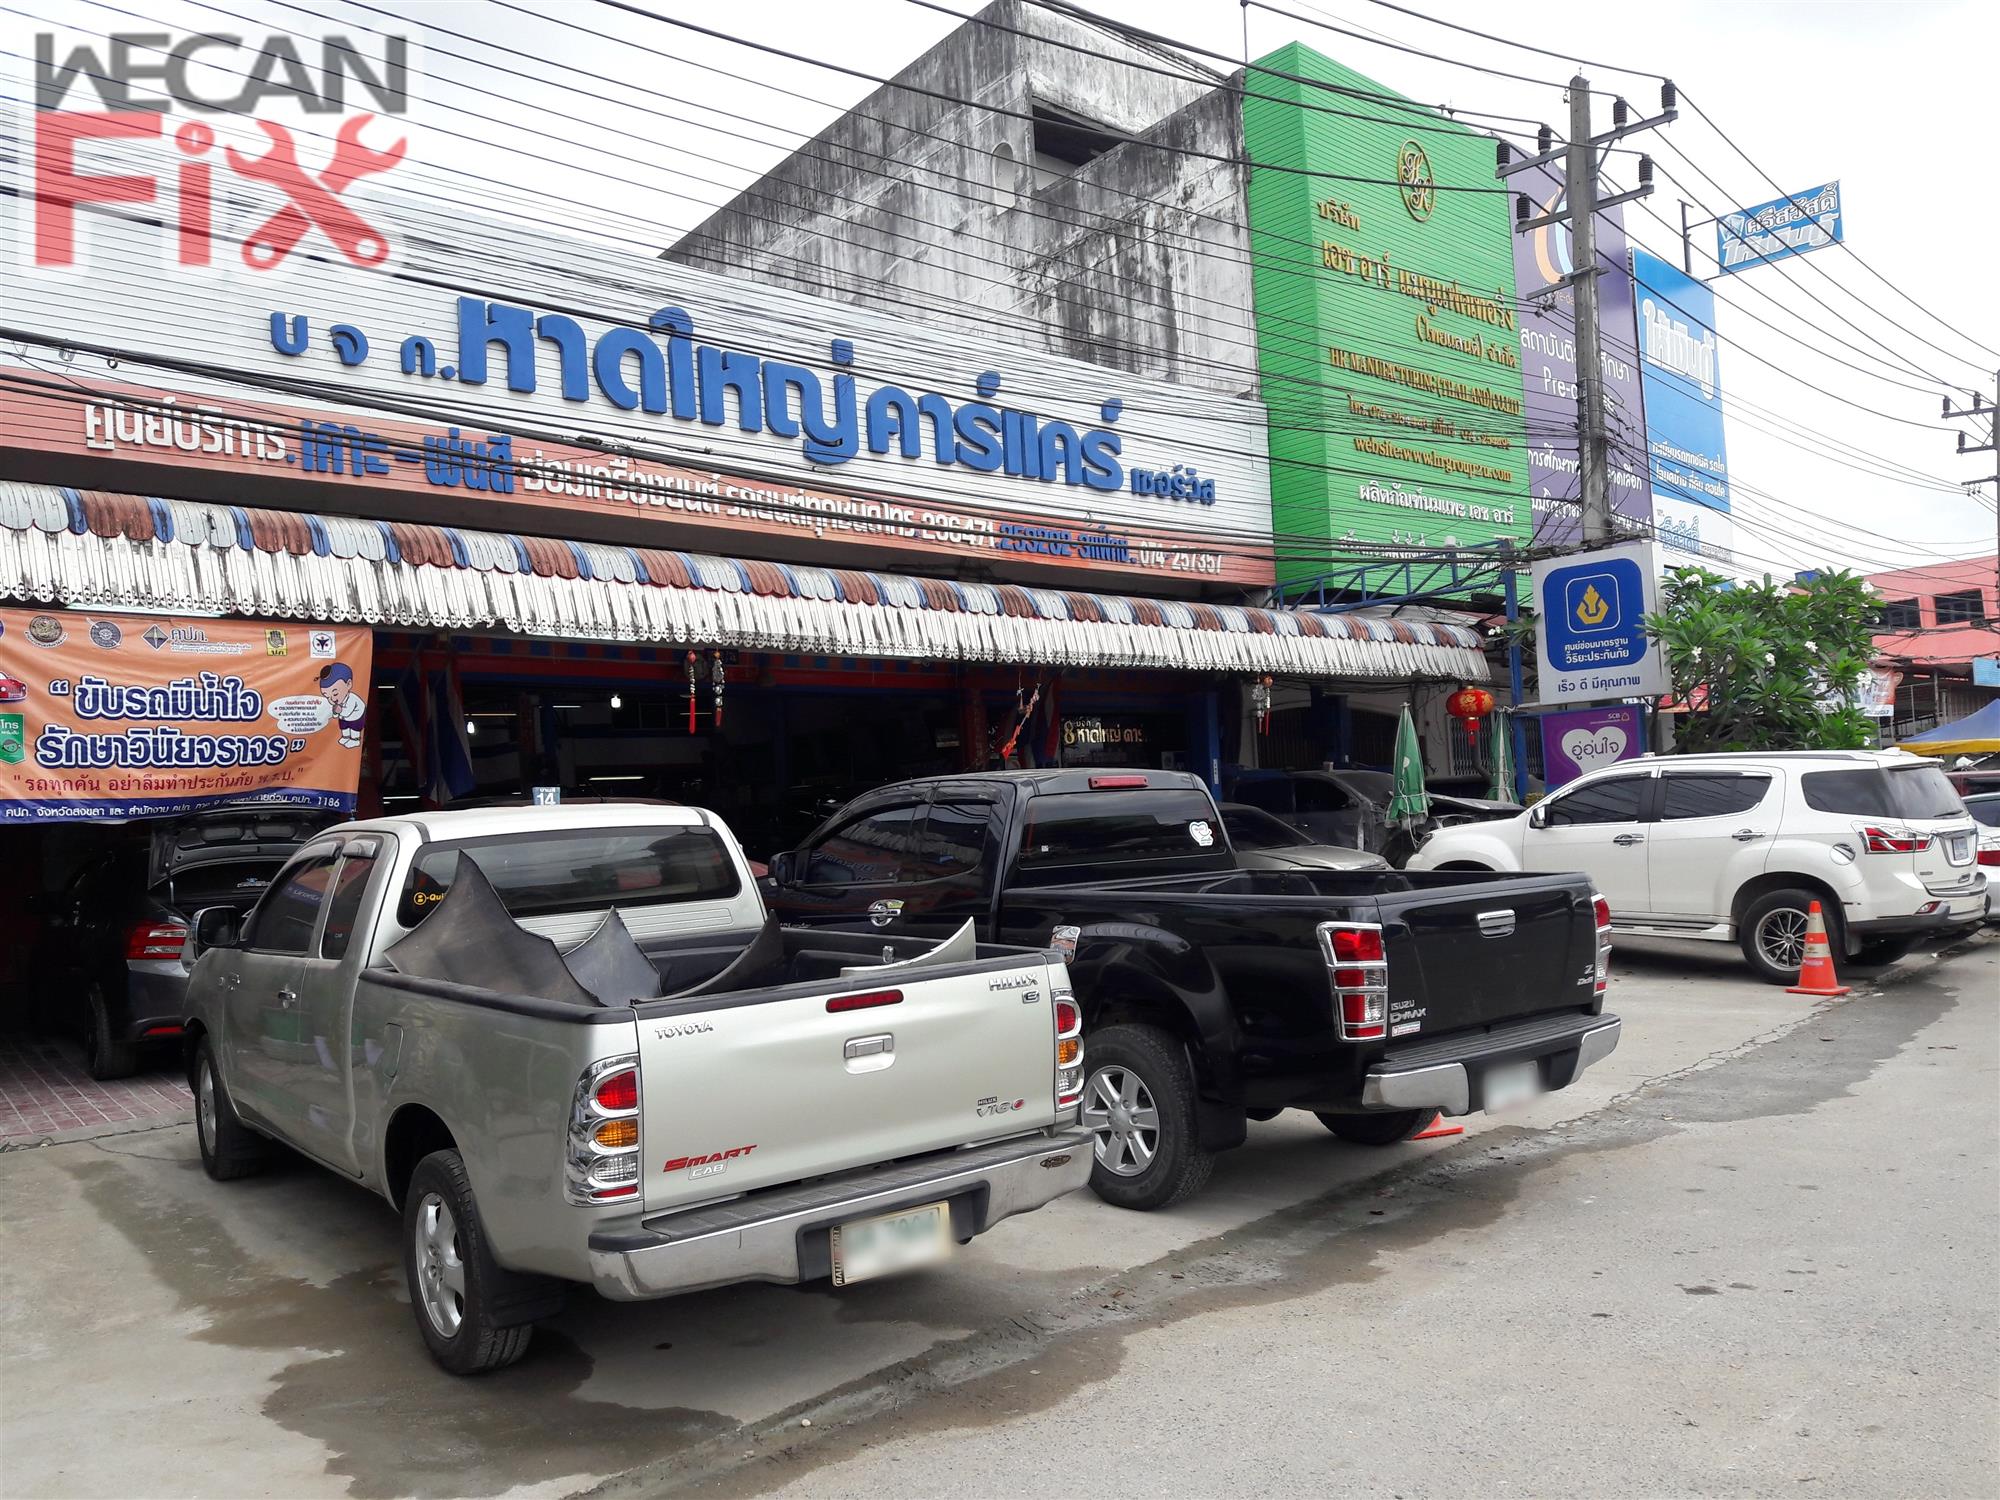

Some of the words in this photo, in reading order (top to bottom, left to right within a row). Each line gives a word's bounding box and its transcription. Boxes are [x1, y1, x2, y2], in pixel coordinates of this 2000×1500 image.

[1318, 198, 1361, 231] บริษัท
[458, 296, 1125, 492] หาดใหญ่คาร์แคร์
[1130, 463, 1216, 506] เซอร์วิส
[424, 427, 514, 494] พ่นสี
[1469, 505, 1490, 521] เอช
[1494, 505, 1514, 525] อาร์
[1564, 637, 1629, 652] ศูนย์ซ่อมมาตรฐาน
[1565, 648, 1630, 664] วิริยะประกันภัย
[1558, 678, 1576, 693] เร็ว
[1580, 677, 1588, 690] ดี
[1592, 676, 1641, 693] มีคุณภาพ
[1571, 737, 1620, 760] อู่อุ่นใจ
[109, 771, 254, 792] อย่าลืมทำประกันภัย
[317, 796, 340, 808] 1186
[1584, 964, 1594, 975] Z
[989, 973, 1039, 991] HILUX
[1391, 1000, 1415, 1011] ISUZU
[655, 1019, 714, 1040] TOYOTA
[692, 1162, 725, 1178] CAB
